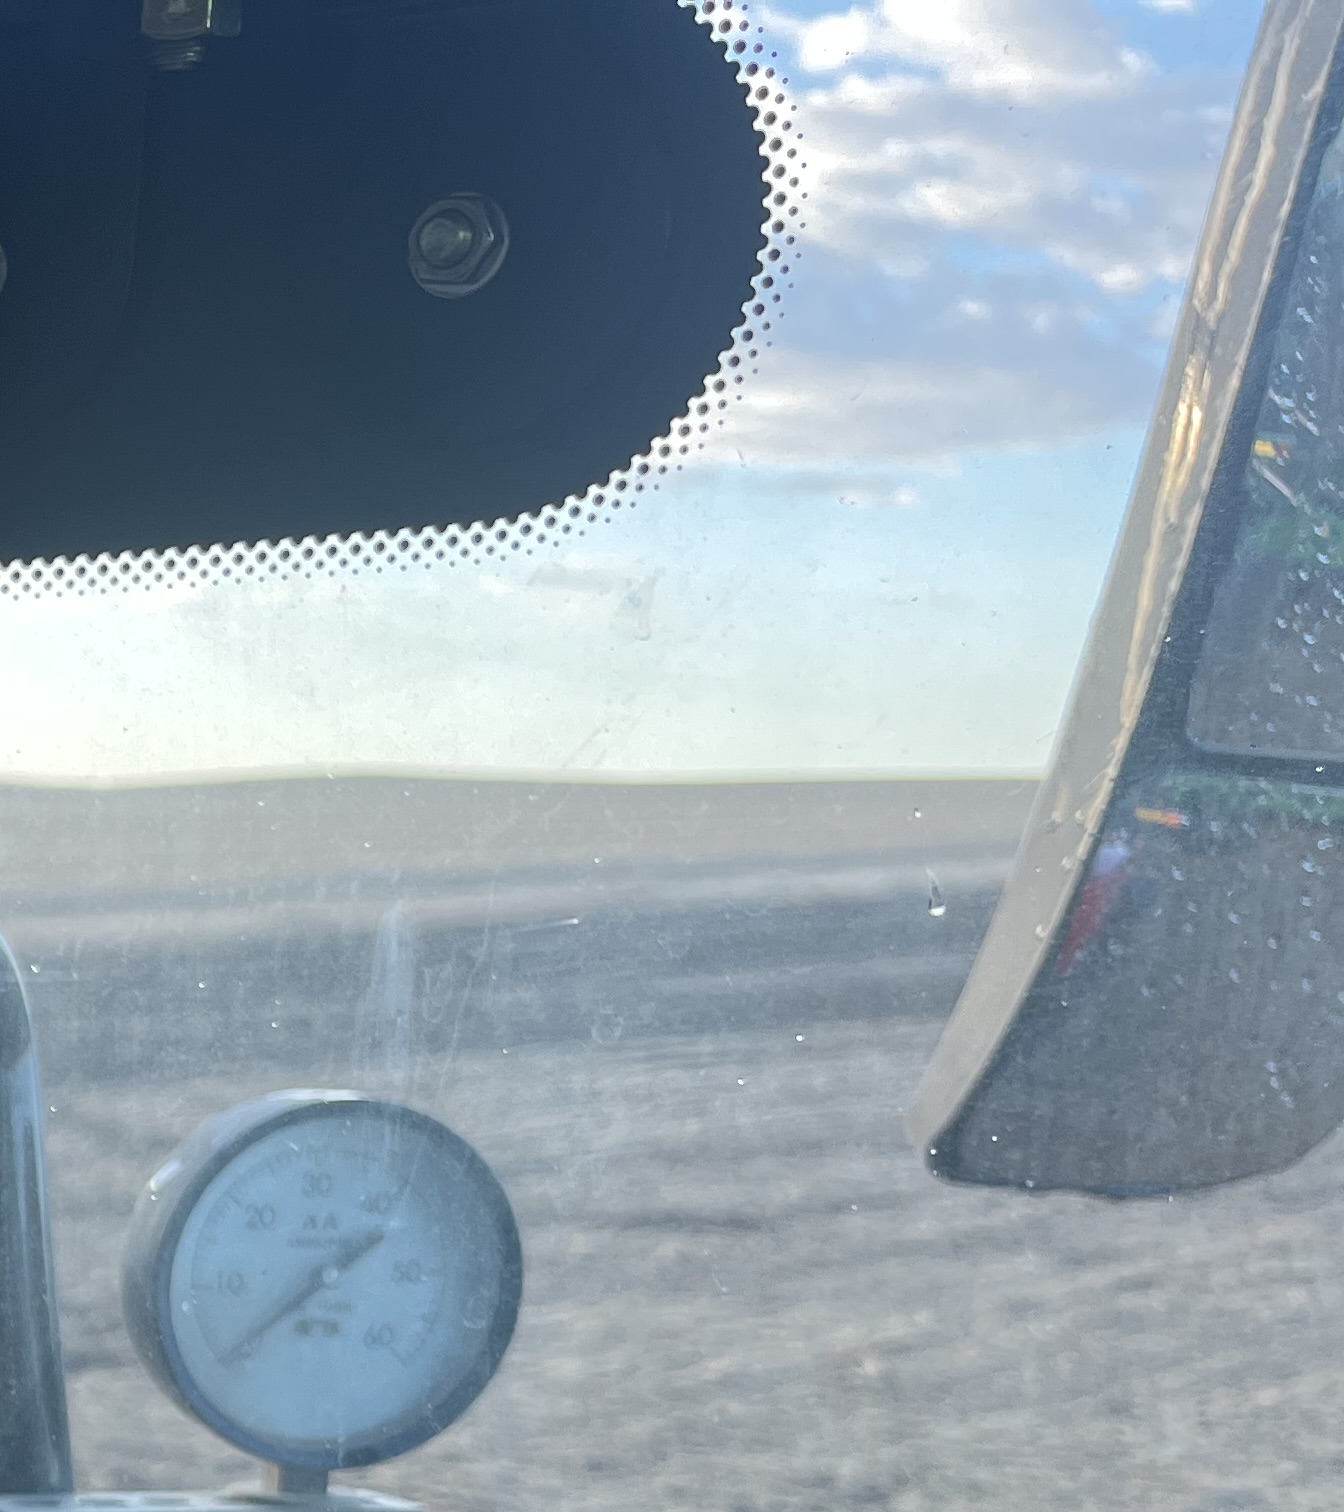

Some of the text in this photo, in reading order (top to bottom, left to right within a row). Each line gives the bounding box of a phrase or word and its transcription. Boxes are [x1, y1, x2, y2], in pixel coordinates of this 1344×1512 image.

[301, 1171, 334, 1198] 30
[362, 1192, 392, 1214] 40
[244, 1203, 276, 1231] 20
[216, 1269, 246, 1297] 10
[391, 1259, 421, 1285] 50
[362, 1322, 395, 1349] 60
